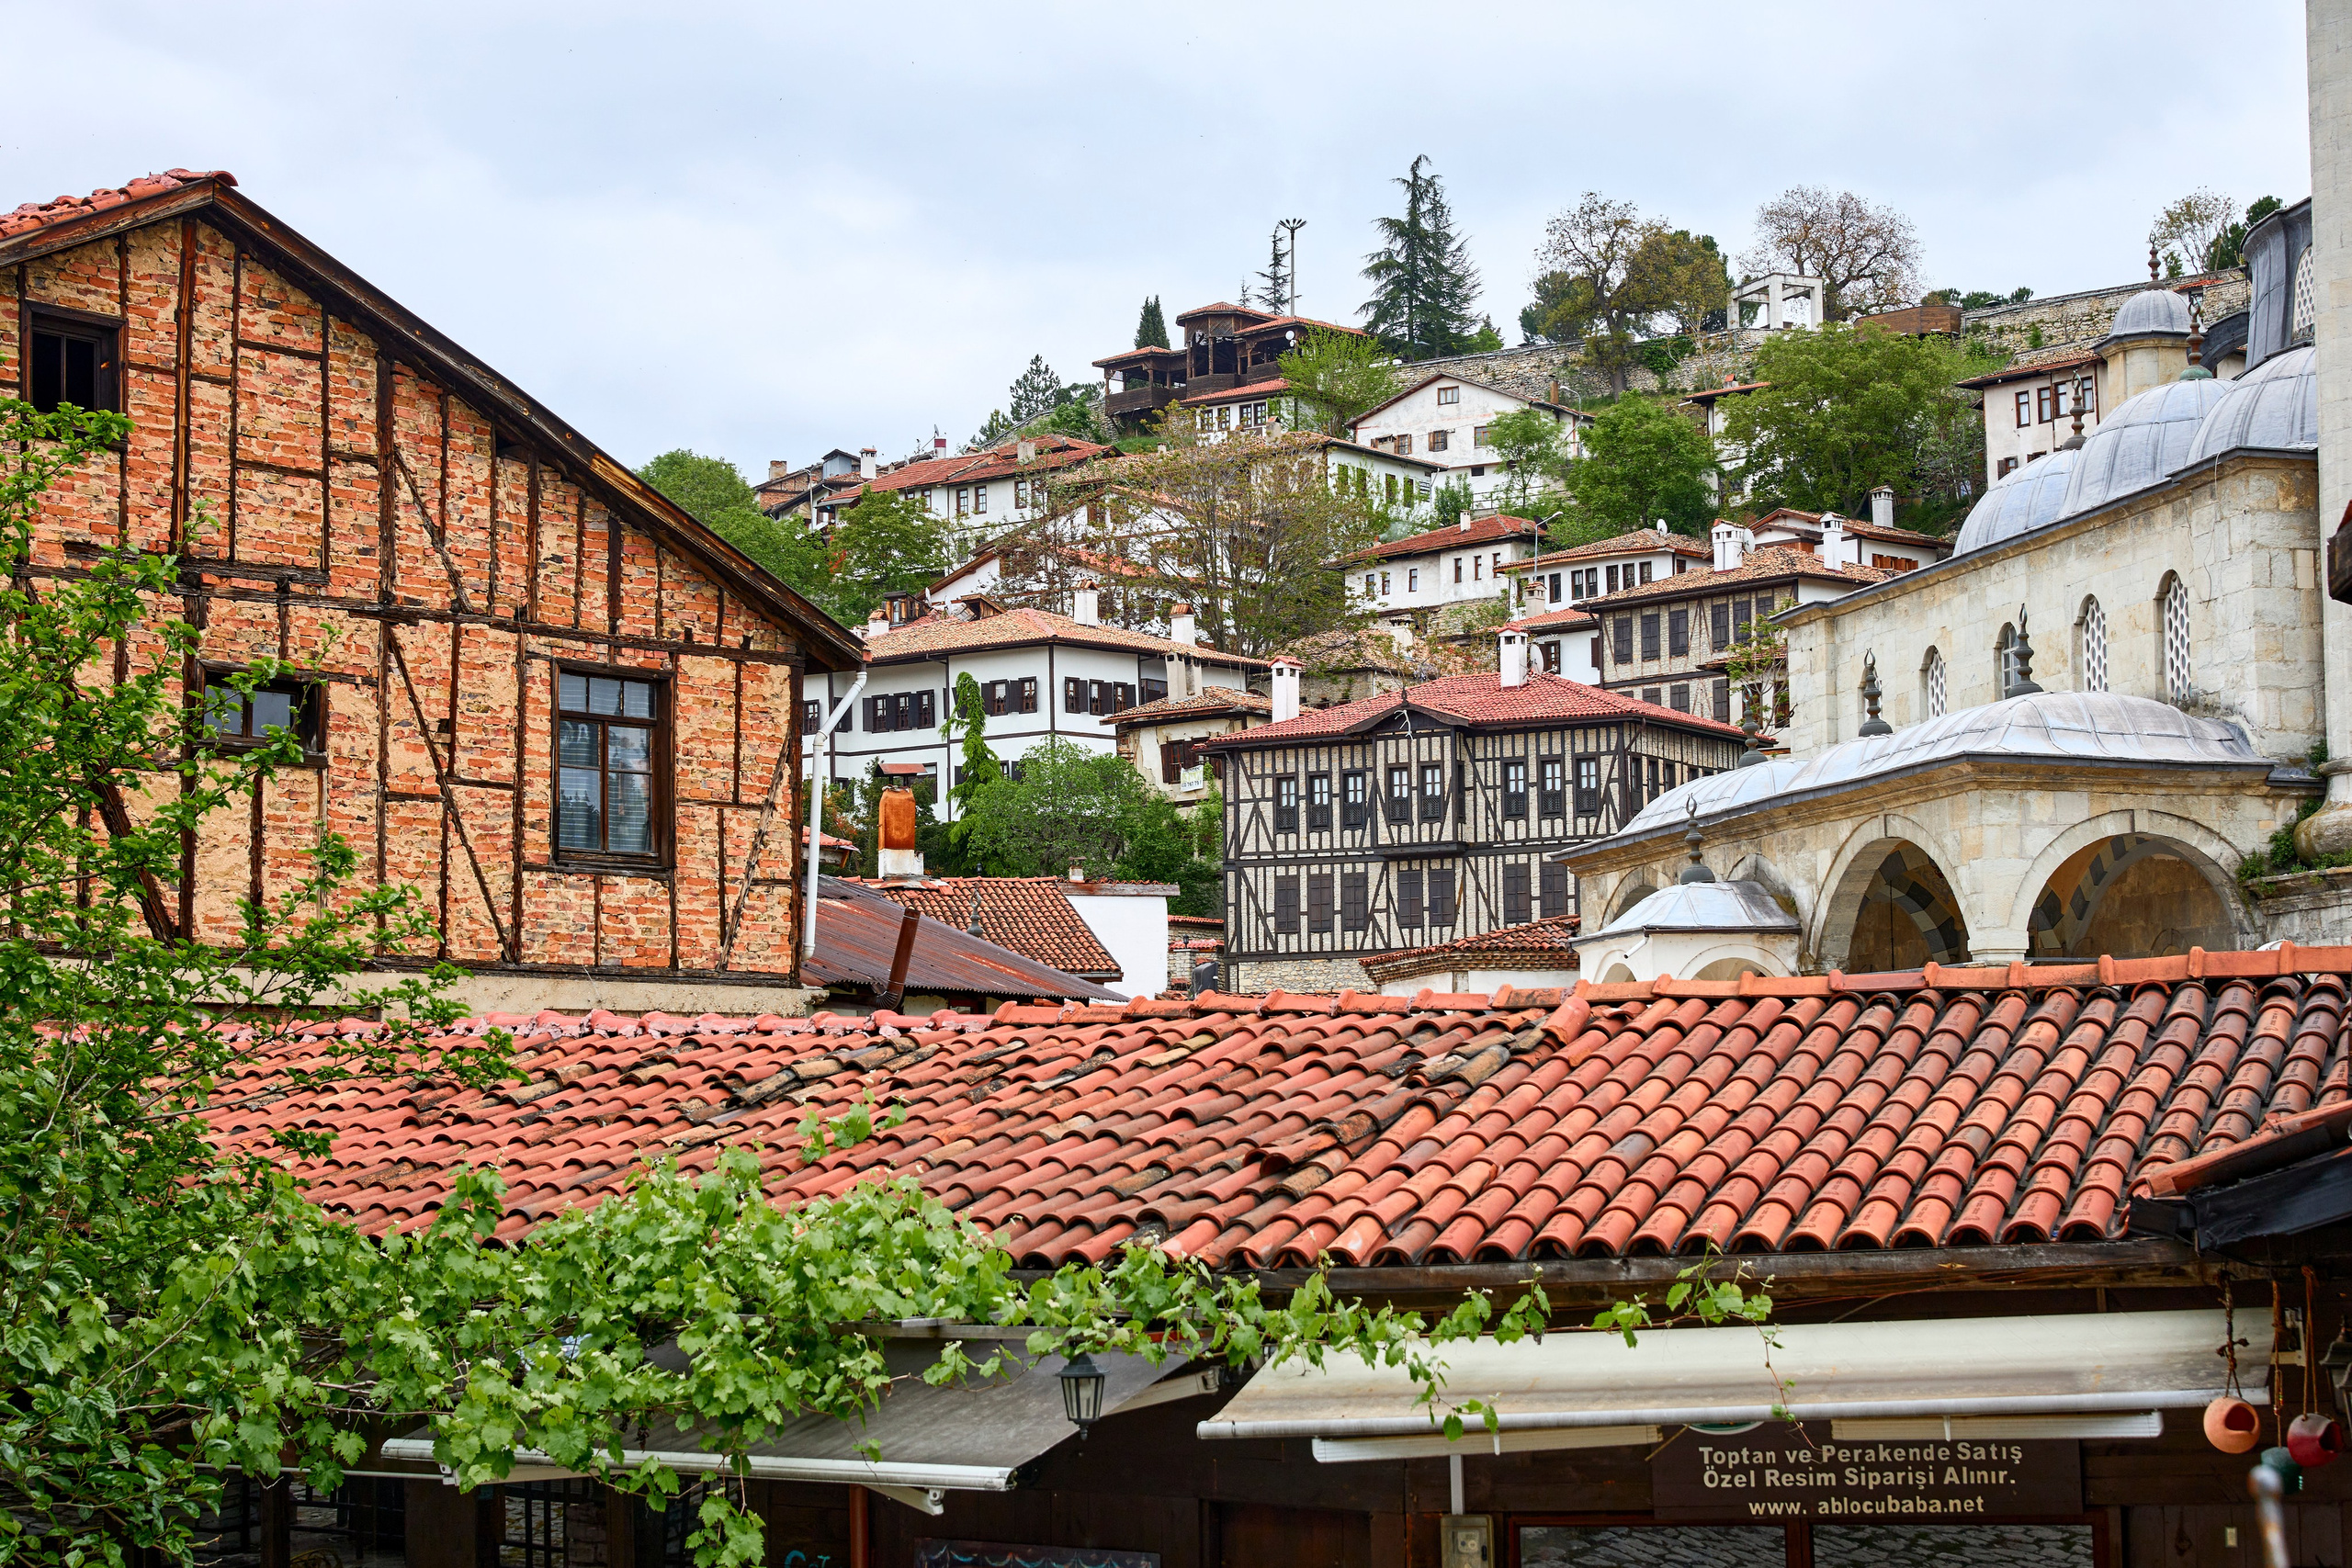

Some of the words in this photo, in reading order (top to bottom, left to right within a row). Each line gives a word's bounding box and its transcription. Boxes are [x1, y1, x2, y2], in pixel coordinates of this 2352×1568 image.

[1698, 1446, 1776, 1470] Toptan
[1784, 1450, 1812, 1464] ve
[1821, 1444, 1951, 1463] Perakende
[1957, 1441, 2022, 1464] Satış
[1702, 1465, 1756, 1488] Özel
[1764, 1466, 1837, 1487] Resim
[1844, 1465, 1935, 1490] Siparişi
[1943, 1466, 2016, 1484] Alınır.
[1817, 1495, 1984, 1515] ablocubaba.net
